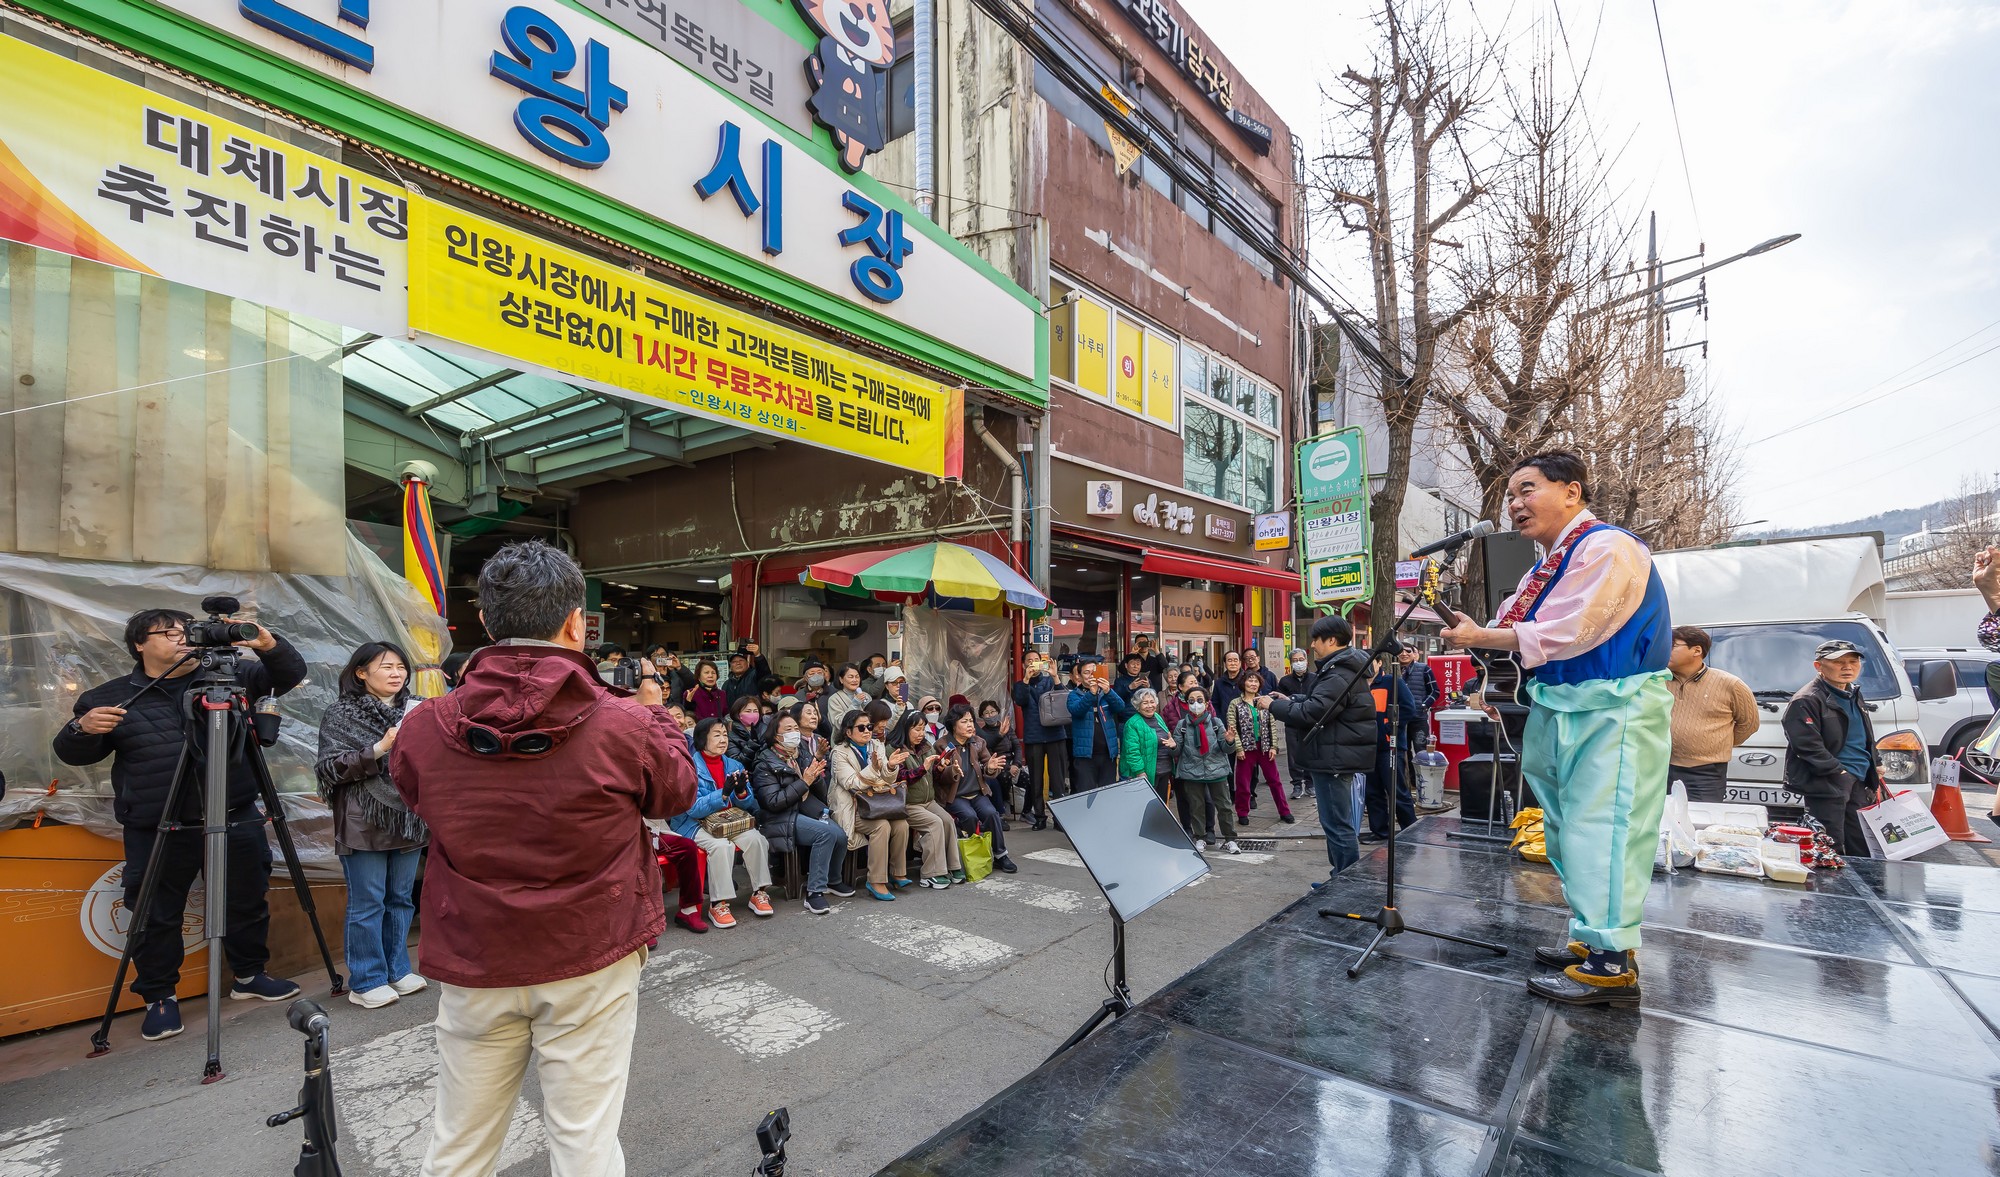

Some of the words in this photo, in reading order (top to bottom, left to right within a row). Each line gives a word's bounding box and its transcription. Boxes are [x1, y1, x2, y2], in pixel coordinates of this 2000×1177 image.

[604, 0, 774, 107] 억뚝방길
[1188, 36, 1233, 111] 당구장
[146, 107, 408, 241] 대체시장
[97, 164, 386, 292] 추진하는
[444, 224, 636, 322] 인왕시장에서
[645, 296, 720, 350] 구매한
[726, 325, 848, 393] 고객분들께는
[852, 371, 931, 422] 구매금액에
[1077, 333, 1104, 358] 나루터
[500, 291, 623, 358] 상관없이
[632, 333, 698, 382] 1시간
[707, 357, 835, 422] 무료주차권을
[838, 399, 910, 446] 드립니다.
[1124, 359, 1132, 376] 회
[1312, 506, 1330, 515] 서대문
[1332, 498, 1352, 514] 07
[1307, 511, 1360, 529] 인왕시장
[1321, 571, 1360, 587] 애드케이
[1162, 604, 1192, 618] TAKE
[1204, 608, 1224, 620] OUT
[1039, 634, 1049, 642] 18
[1759, 790, 1803, 804] 0199
